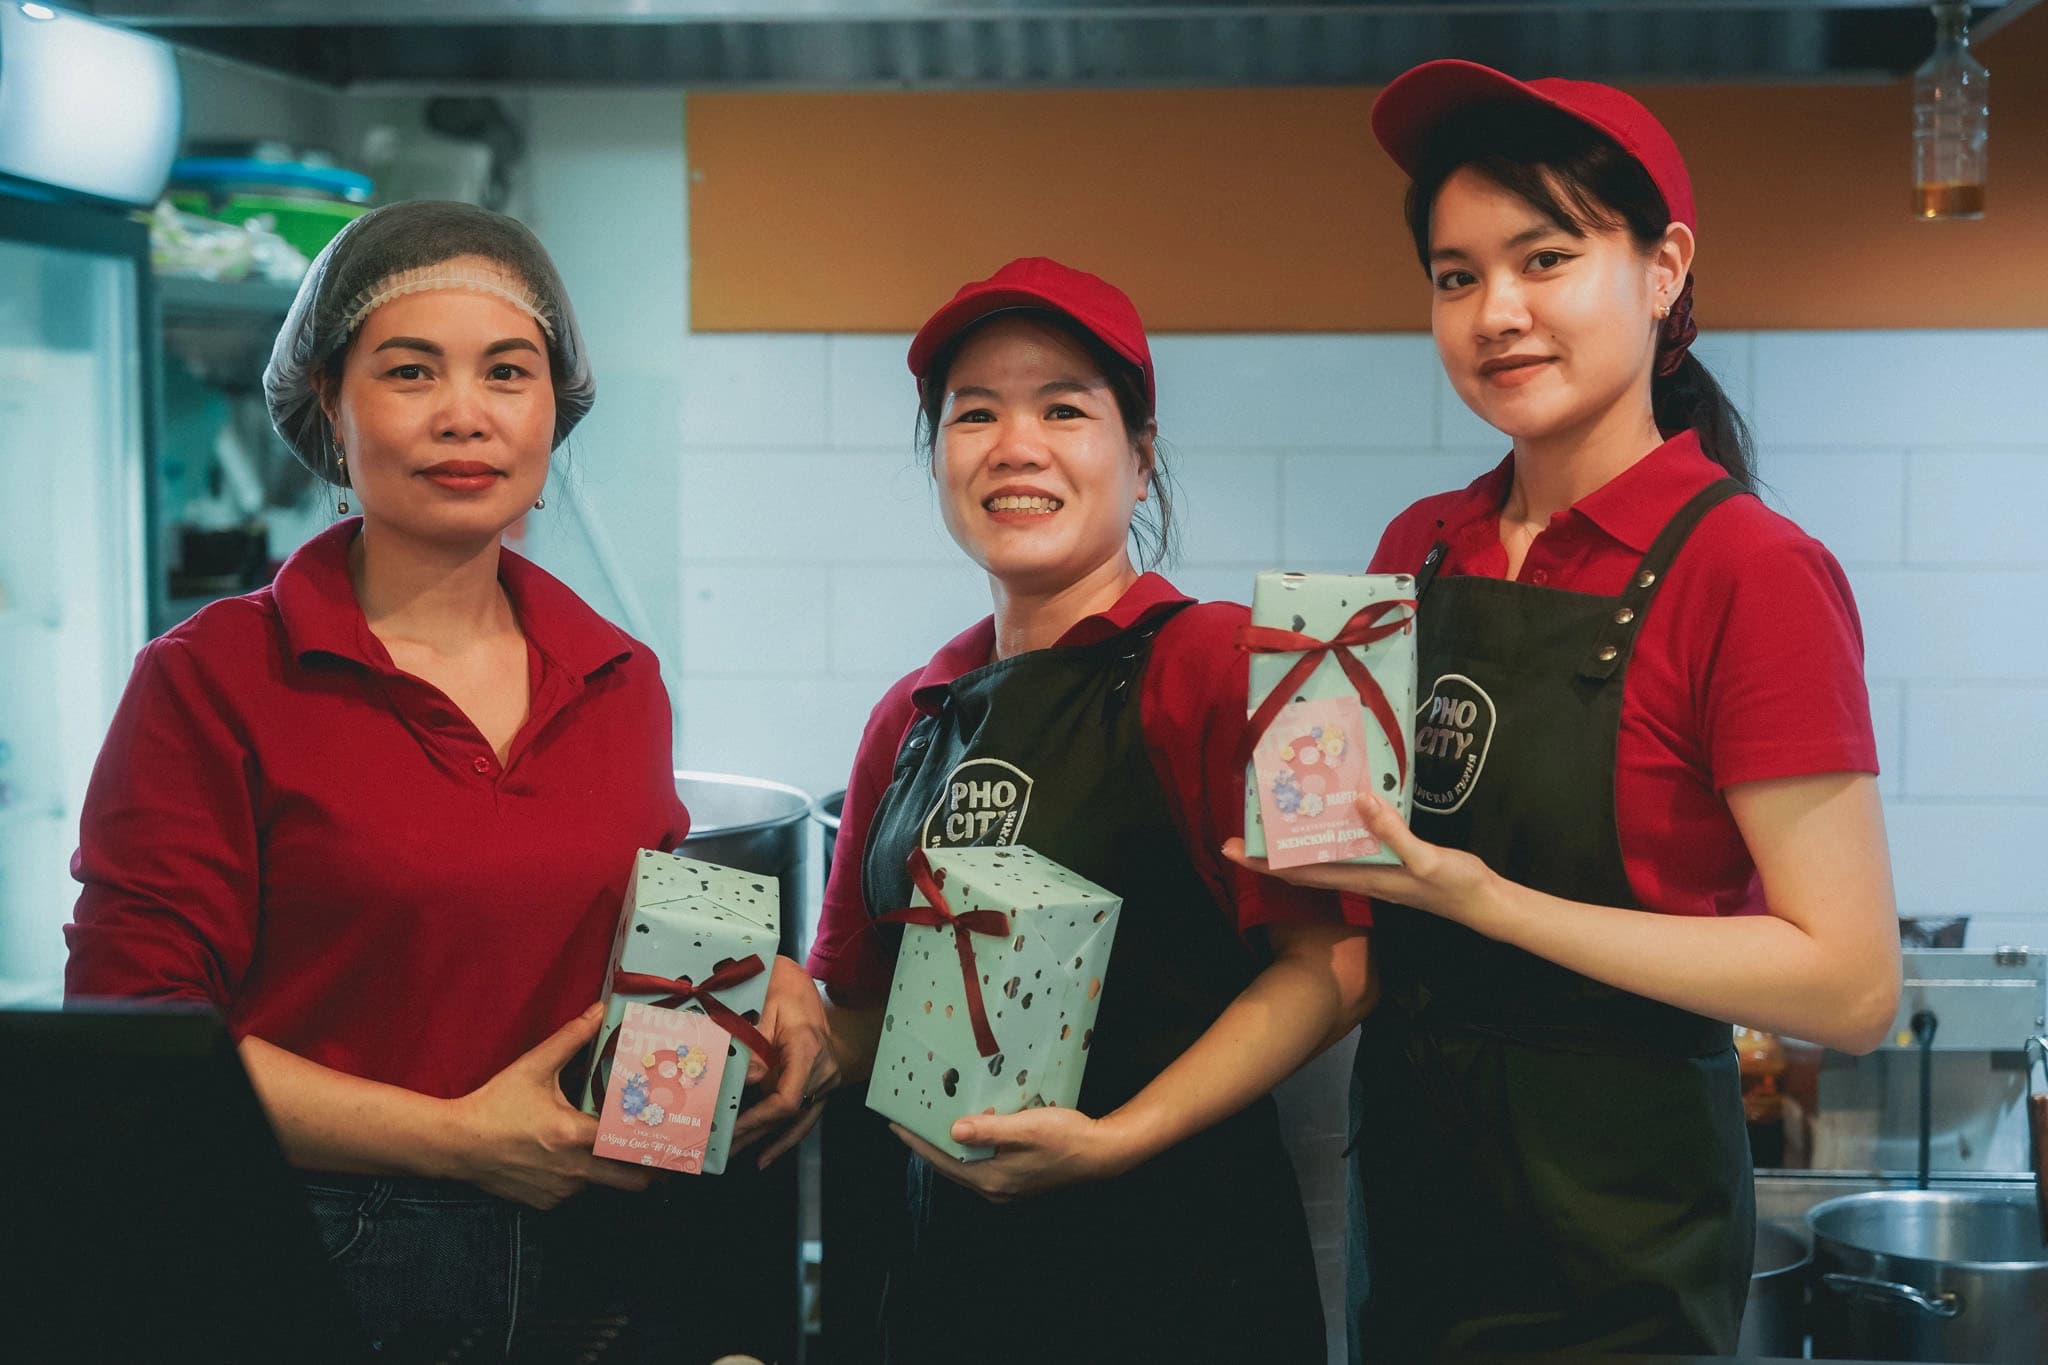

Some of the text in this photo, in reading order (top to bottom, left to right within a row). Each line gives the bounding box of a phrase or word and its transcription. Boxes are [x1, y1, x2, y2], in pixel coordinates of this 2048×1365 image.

[1428, 696, 1477, 729] PHO
[1415, 726, 1474, 760] CITY
[1454, 753, 1478, 795] КУХНЯ
[951, 780, 1017, 811] PHO
[1277, 829, 1335, 850] ЖЕНСКИЙ
